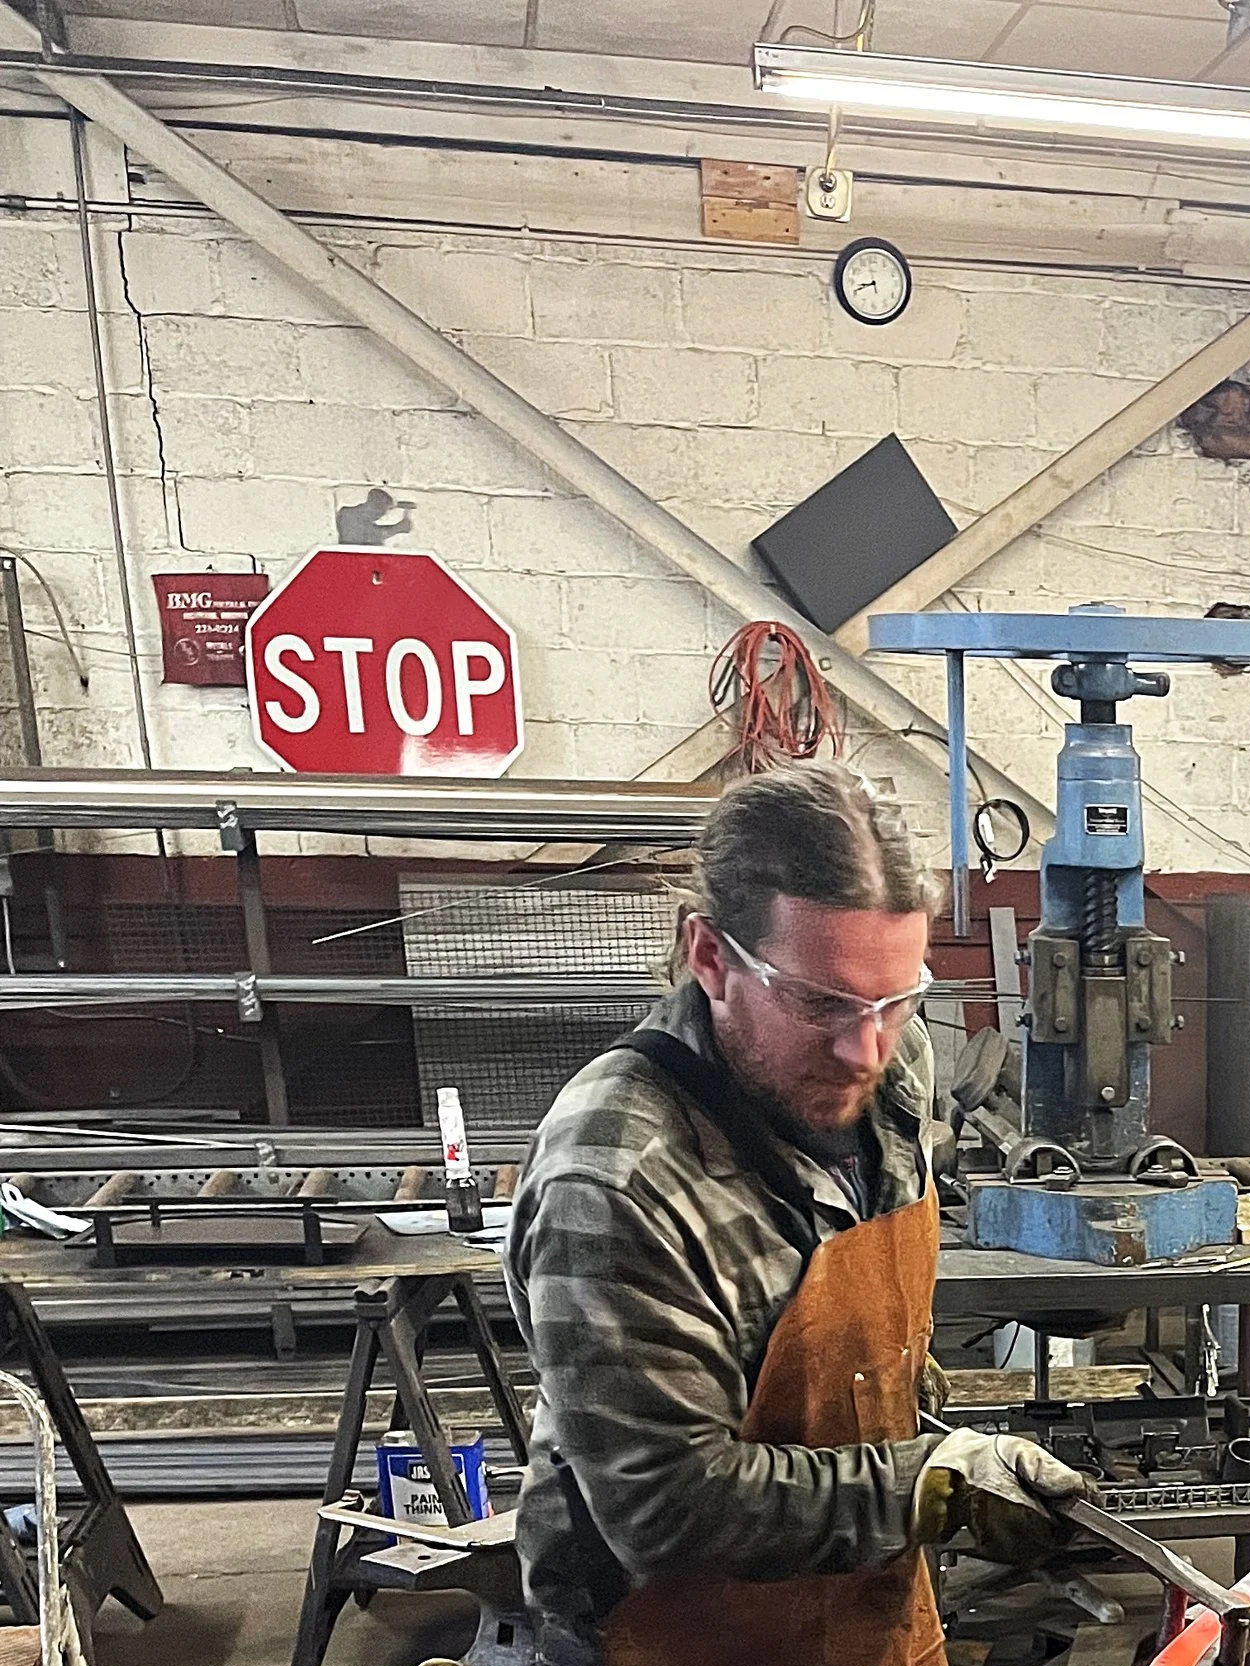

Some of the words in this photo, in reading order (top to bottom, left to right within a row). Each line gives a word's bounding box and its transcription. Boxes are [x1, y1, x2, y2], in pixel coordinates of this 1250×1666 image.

[167, 592, 213, 609] BMG
[264, 634, 505, 736] STOP
[411, 1465, 431, 1479] JAS
[411, 1494, 441, 1504] PAIN
[403, 1504, 443, 1515] THINN
